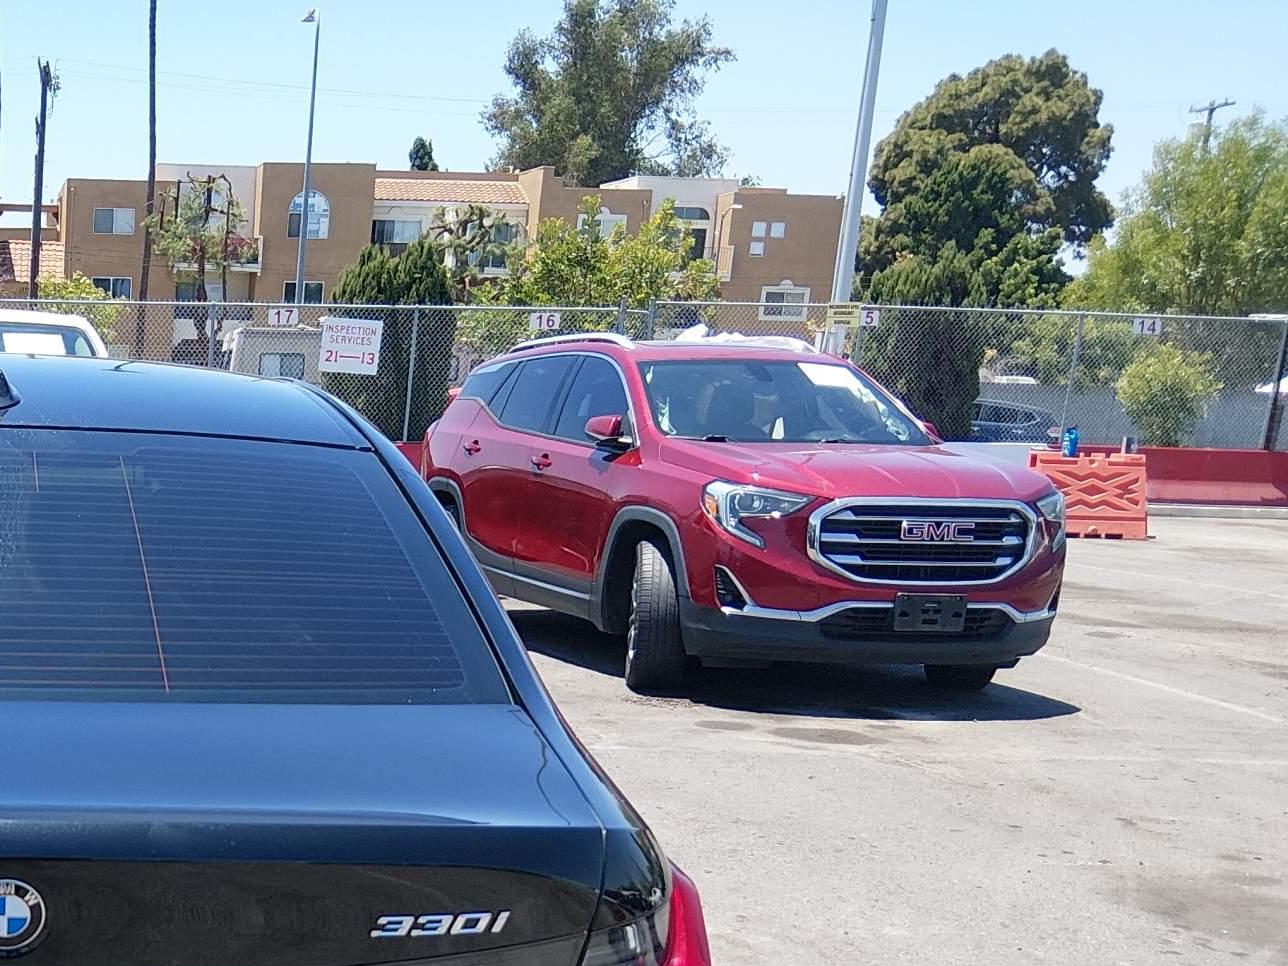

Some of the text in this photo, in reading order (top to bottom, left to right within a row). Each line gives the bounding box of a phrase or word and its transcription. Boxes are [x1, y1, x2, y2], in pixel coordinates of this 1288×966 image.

[274, 310, 294, 324] 17
[536, 314, 556, 328] 16
[325, 324, 377, 336] INSPECTION
[1138, 320, 1156, 334] 14
[330, 335, 372, 346] SERVICES
[900, 521, 975, 541] GMC
